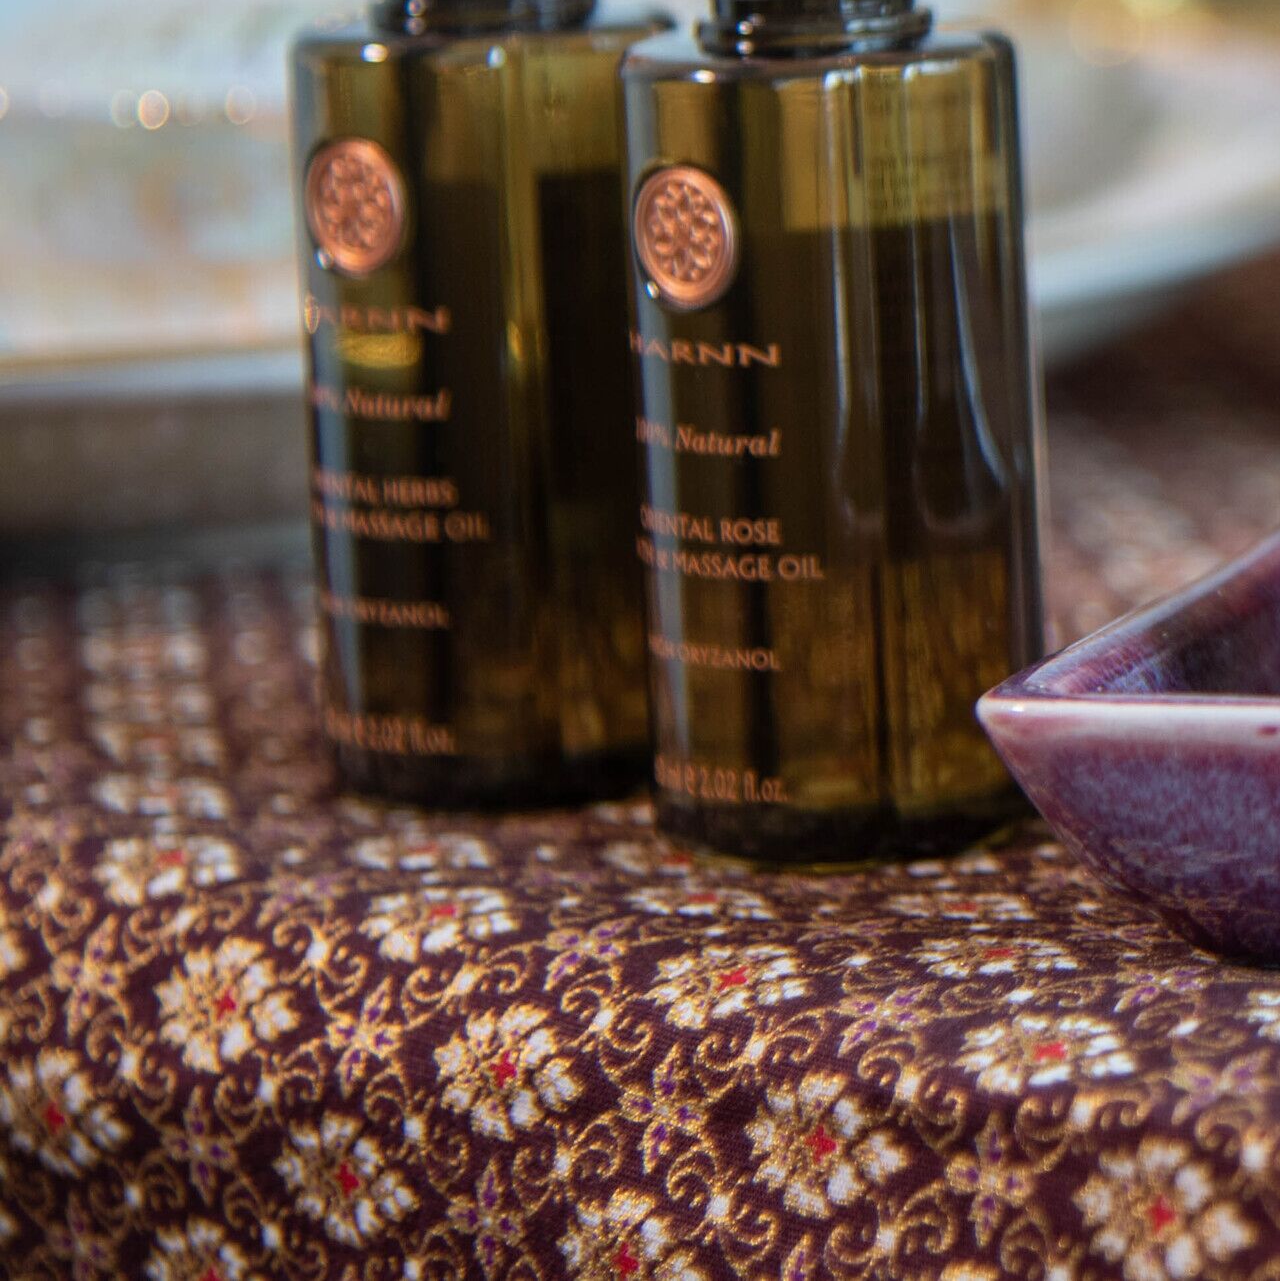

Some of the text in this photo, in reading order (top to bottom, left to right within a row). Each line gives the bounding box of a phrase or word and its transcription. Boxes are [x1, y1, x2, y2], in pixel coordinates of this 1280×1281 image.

[676, 424, 782, 457] Natural
[720, 518, 783, 545] ROSE
[778, 554, 825, 582] OIL
